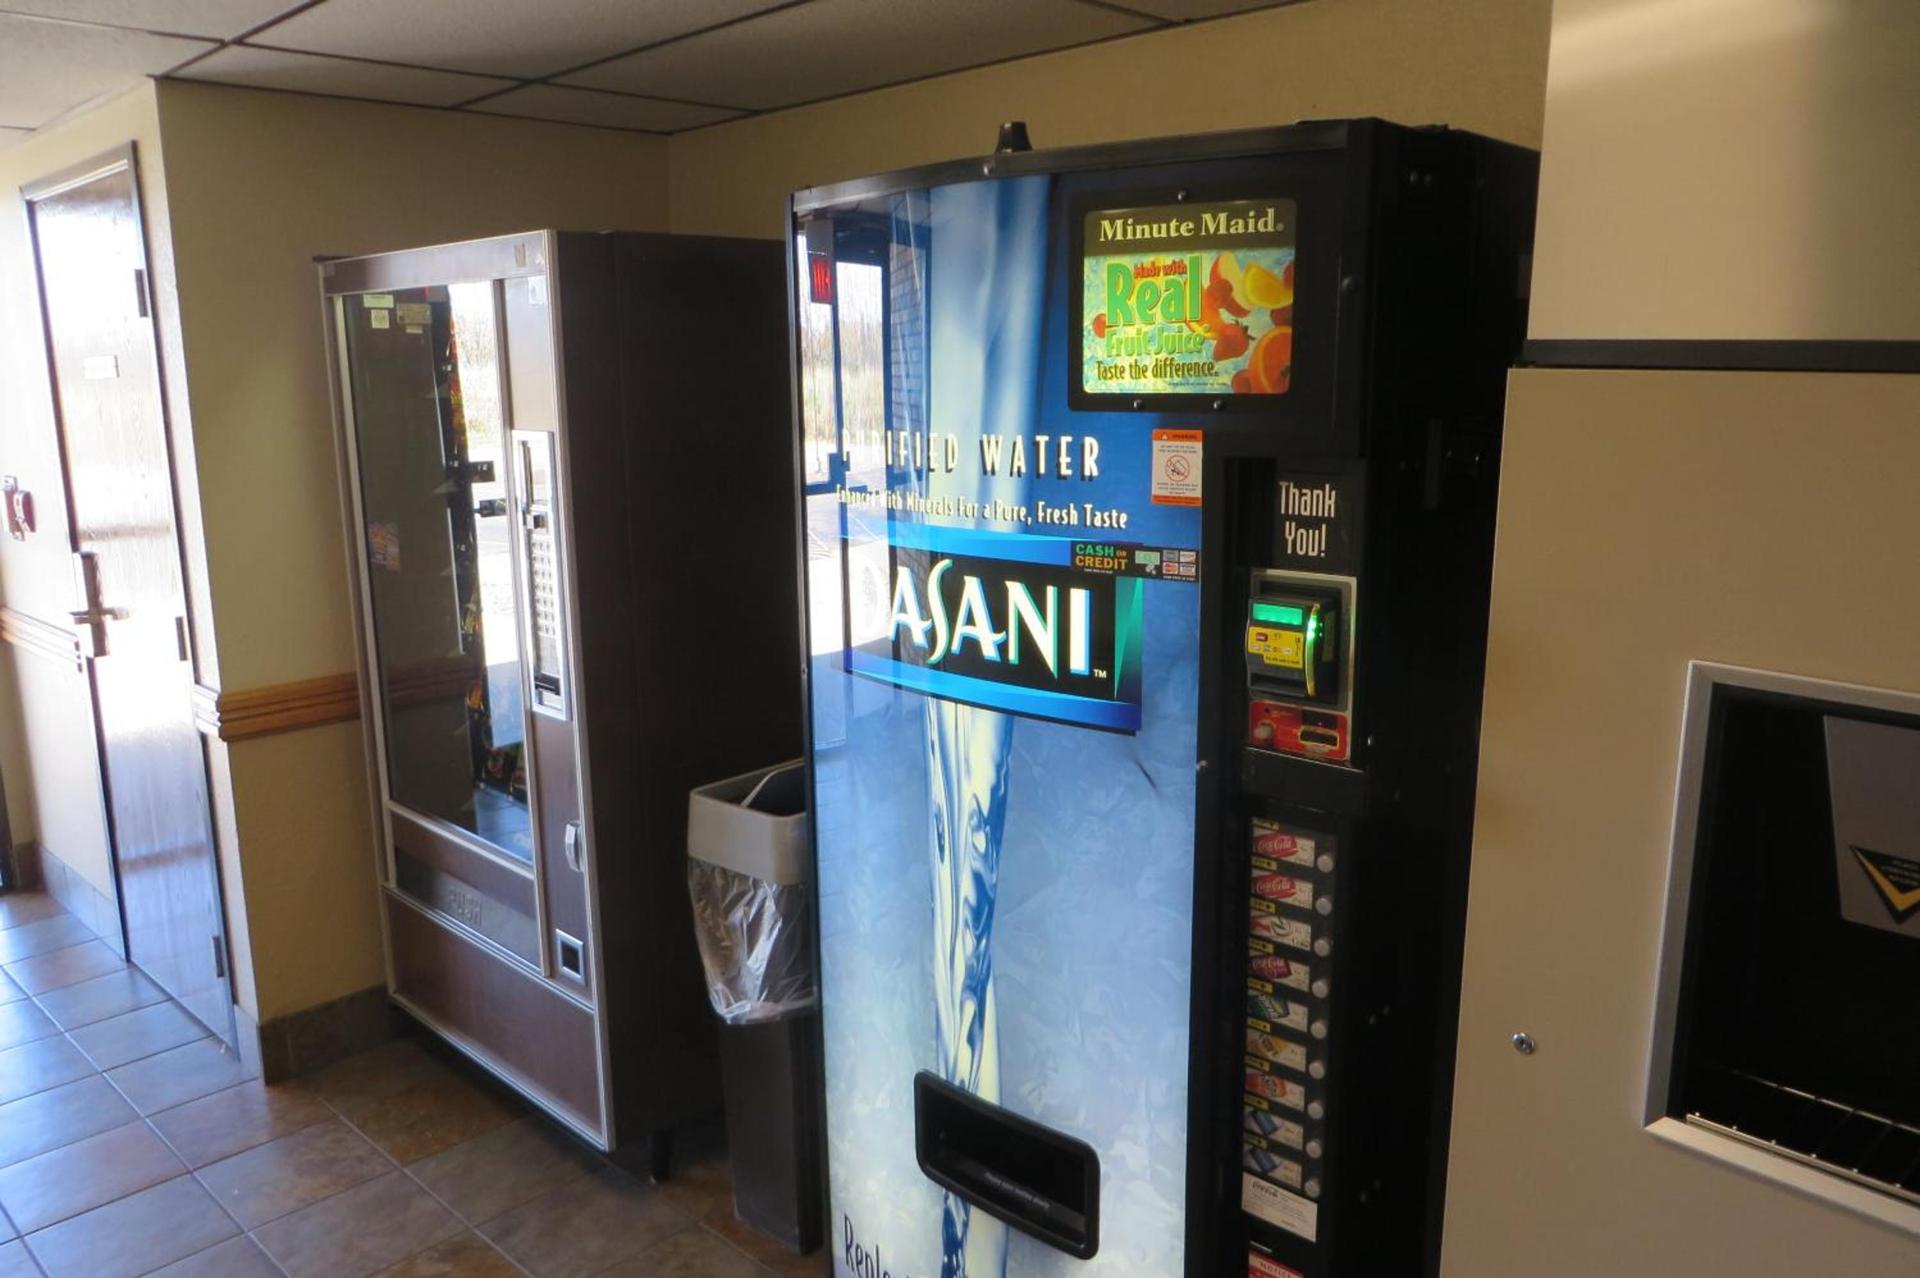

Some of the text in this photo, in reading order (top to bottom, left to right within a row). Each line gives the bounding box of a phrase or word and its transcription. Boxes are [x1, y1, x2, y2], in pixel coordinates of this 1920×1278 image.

[1099, 207, 1276, 242] Minute Maid
[1106, 255, 1203, 326] Real
[1105, 324, 1206, 357] Fruit Juice
[1095, 357, 1217, 381] Taste the difference.
[981, 433, 1101, 479] WATER
[836, 483, 878, 507] Enhance
[905, 490, 954, 517] Minerals
[957, 497, 979, 519] For
[982, 502, 991, 520] a
[993, 499, 1032, 527] Pure,
[1037, 501, 1079, 526] Fresh
[1082, 504, 1129, 530] Taste
[1279, 480, 1337, 518] Thank
[1075, 543, 1115, 557] CASH
[1284, 520, 1327, 558] You!
[1075, 555, 1129, 571] CREDIT
[880, 558, 1093, 680] ASANI
